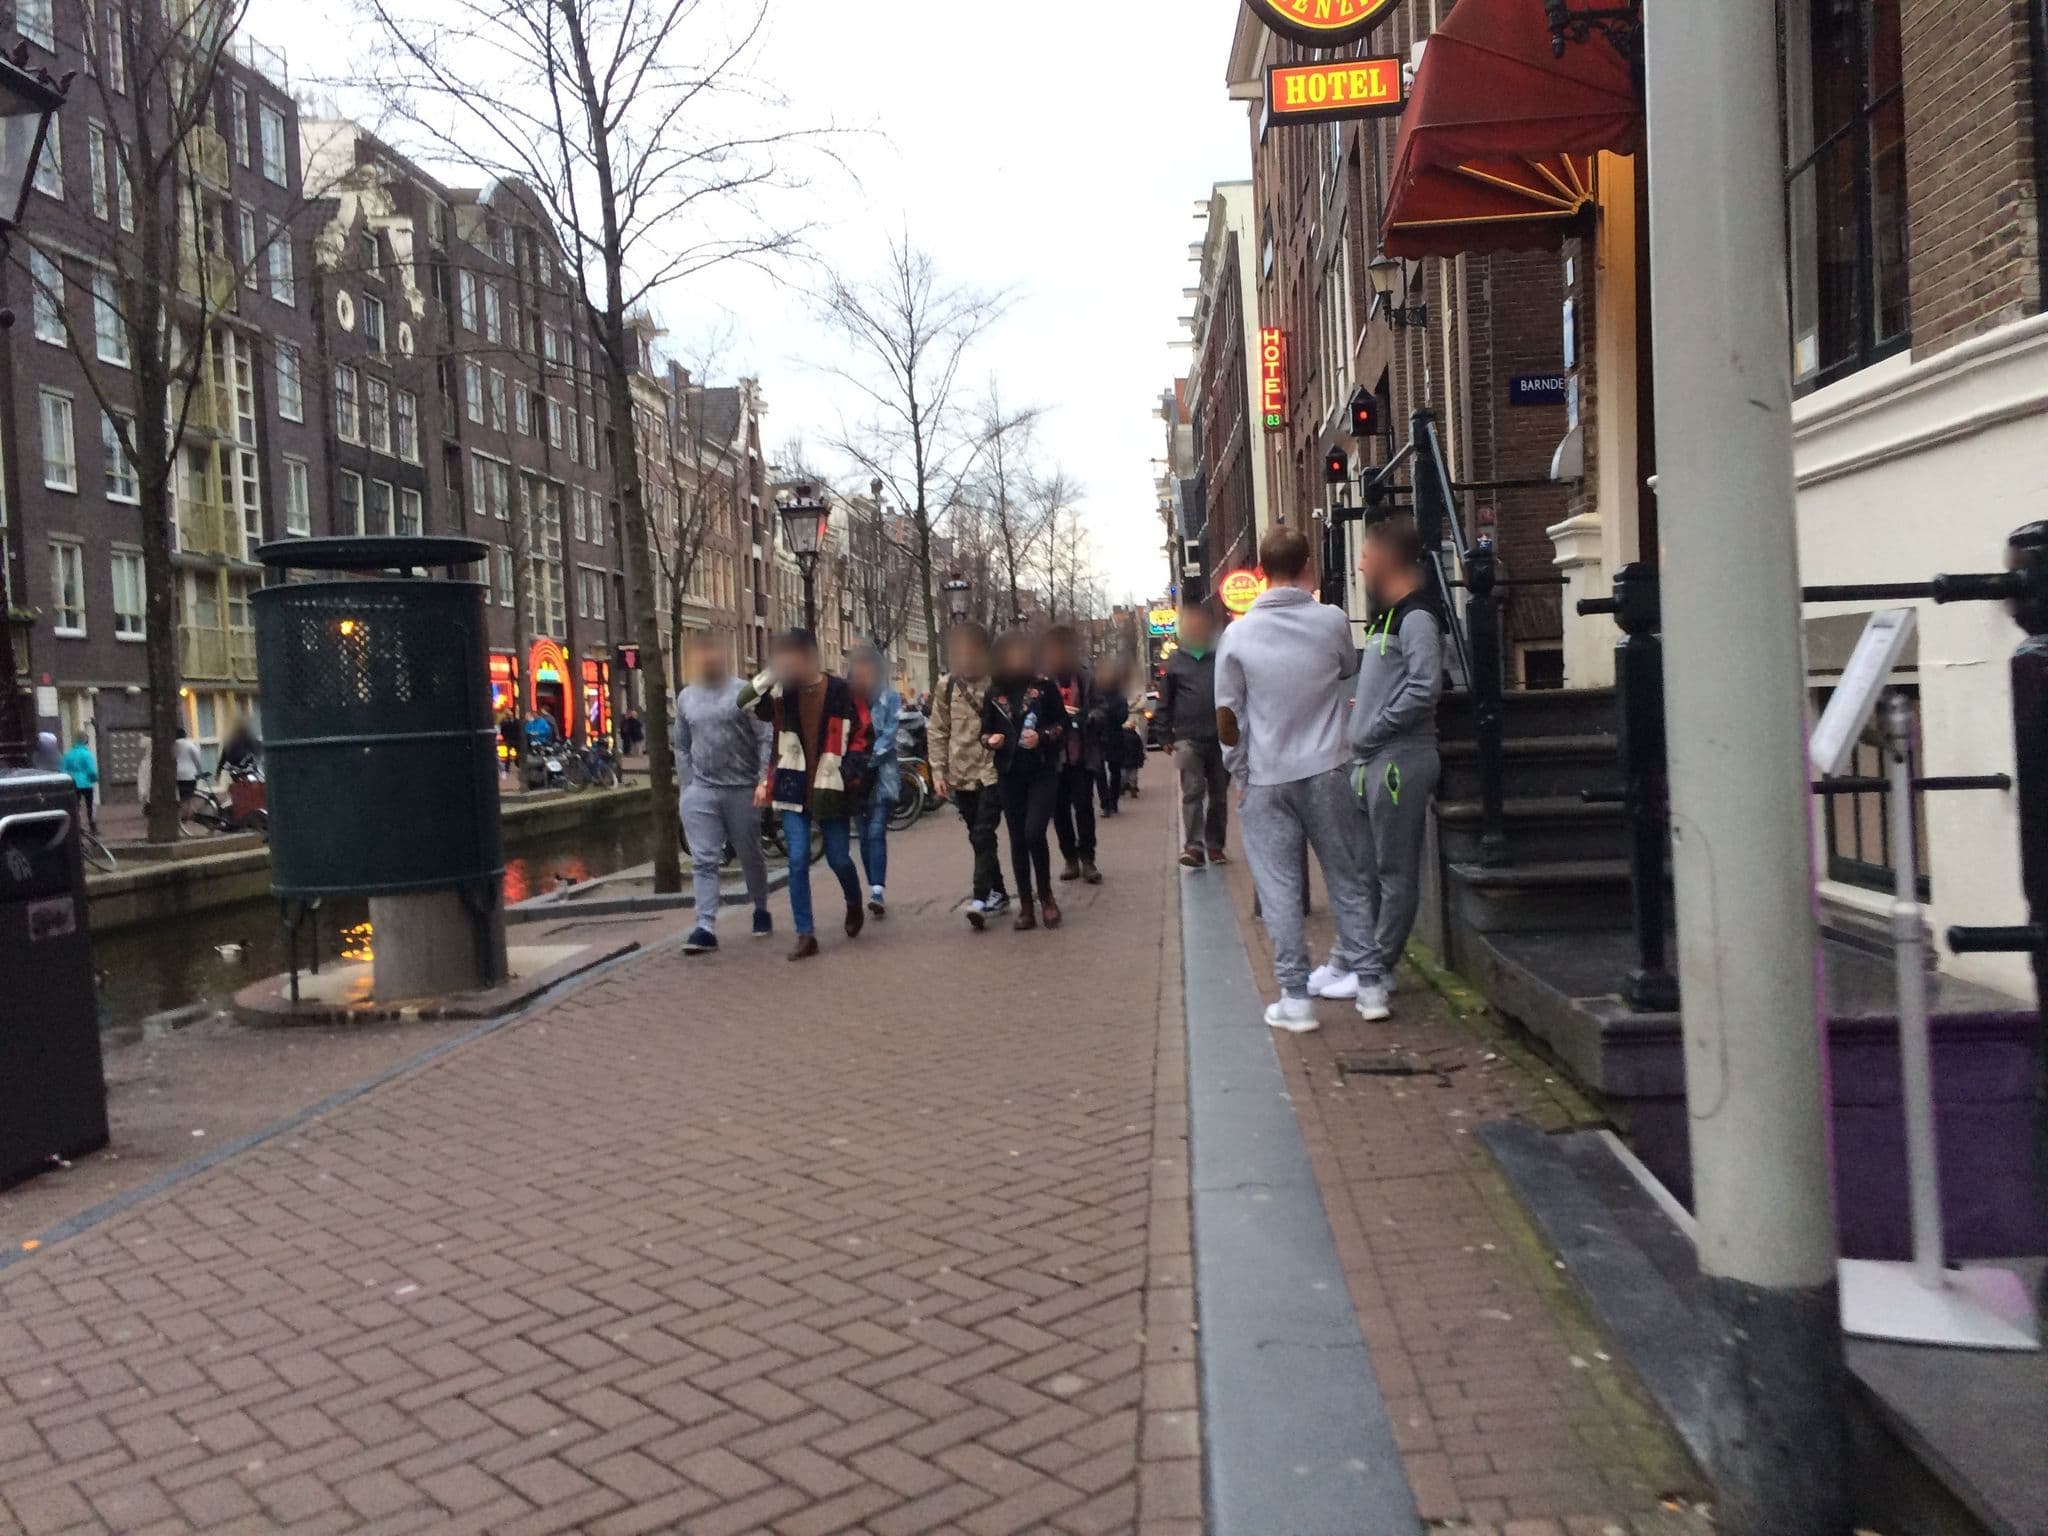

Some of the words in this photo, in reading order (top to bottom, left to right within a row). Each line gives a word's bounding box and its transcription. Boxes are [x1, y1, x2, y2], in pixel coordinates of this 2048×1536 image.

[1285, 69, 1387, 104] HOTEL
[1263, 329, 1281, 410] HOTEL
[1267, 414, 1280, 426] 83
